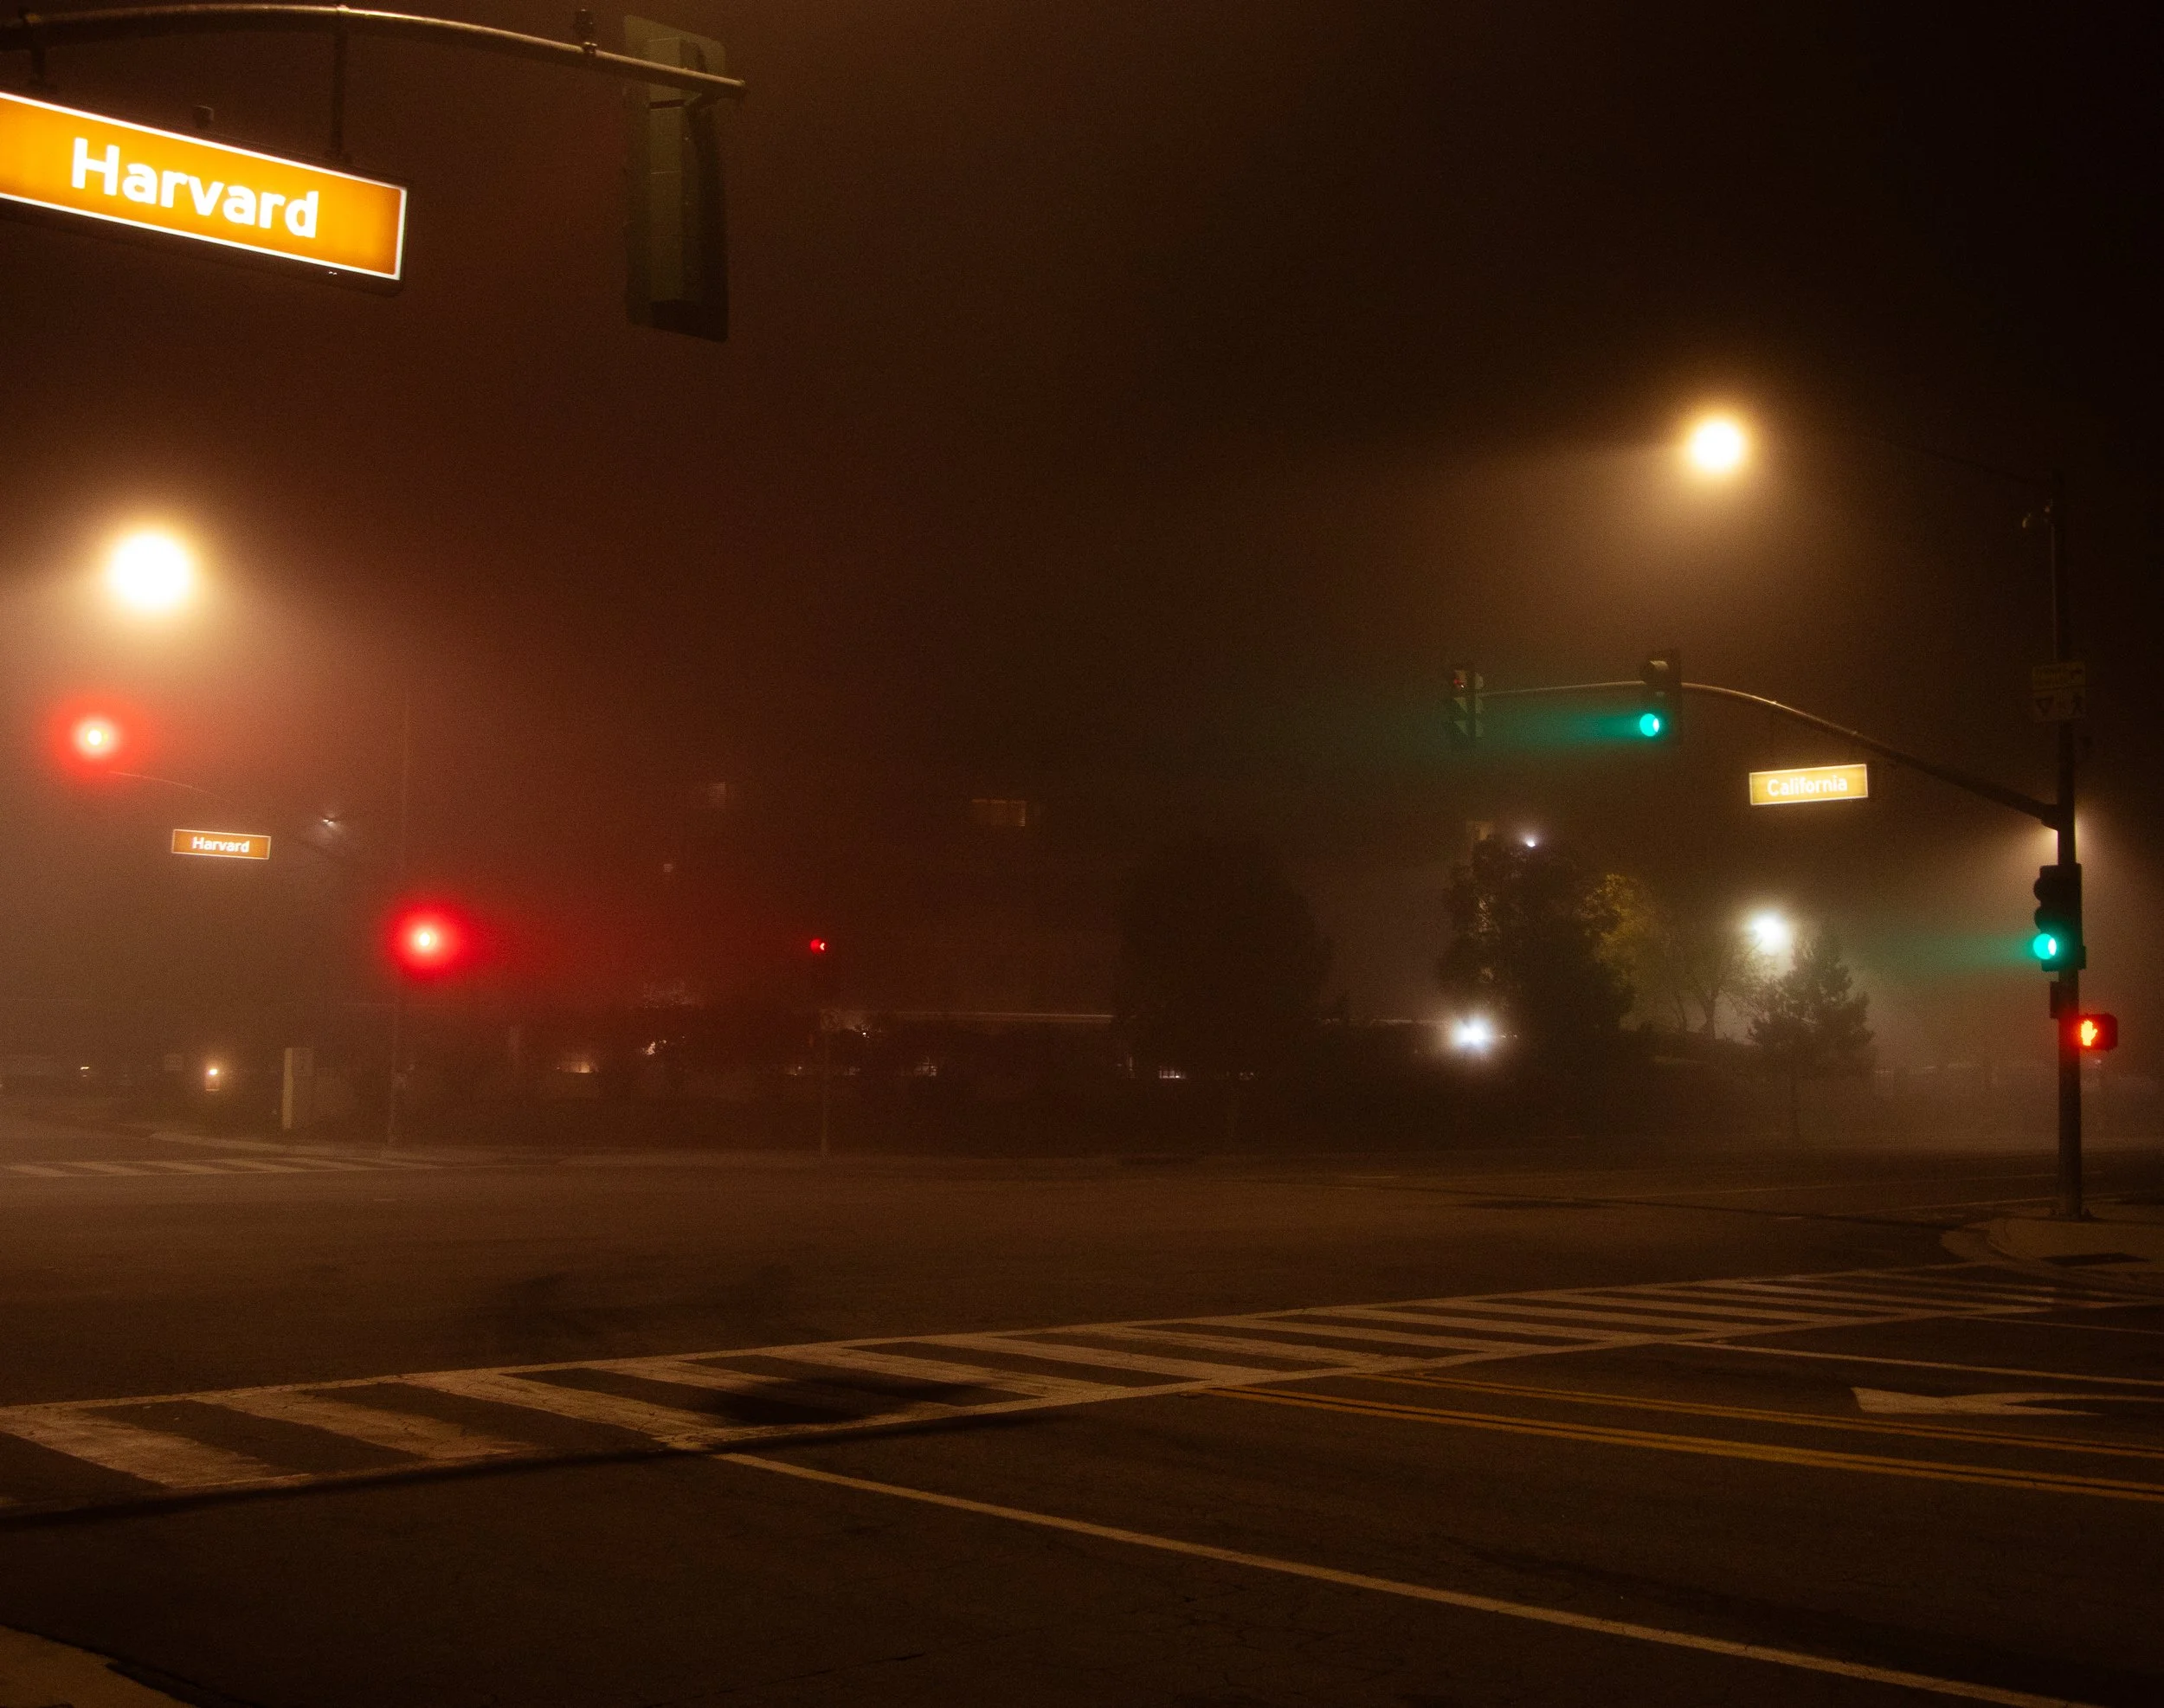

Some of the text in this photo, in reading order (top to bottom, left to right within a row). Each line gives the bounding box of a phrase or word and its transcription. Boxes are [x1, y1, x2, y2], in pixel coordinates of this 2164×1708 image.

[71, 137, 319, 238] Harvard
[1768, 775, 1848, 796] California
[192, 836, 250, 853] Harvard
